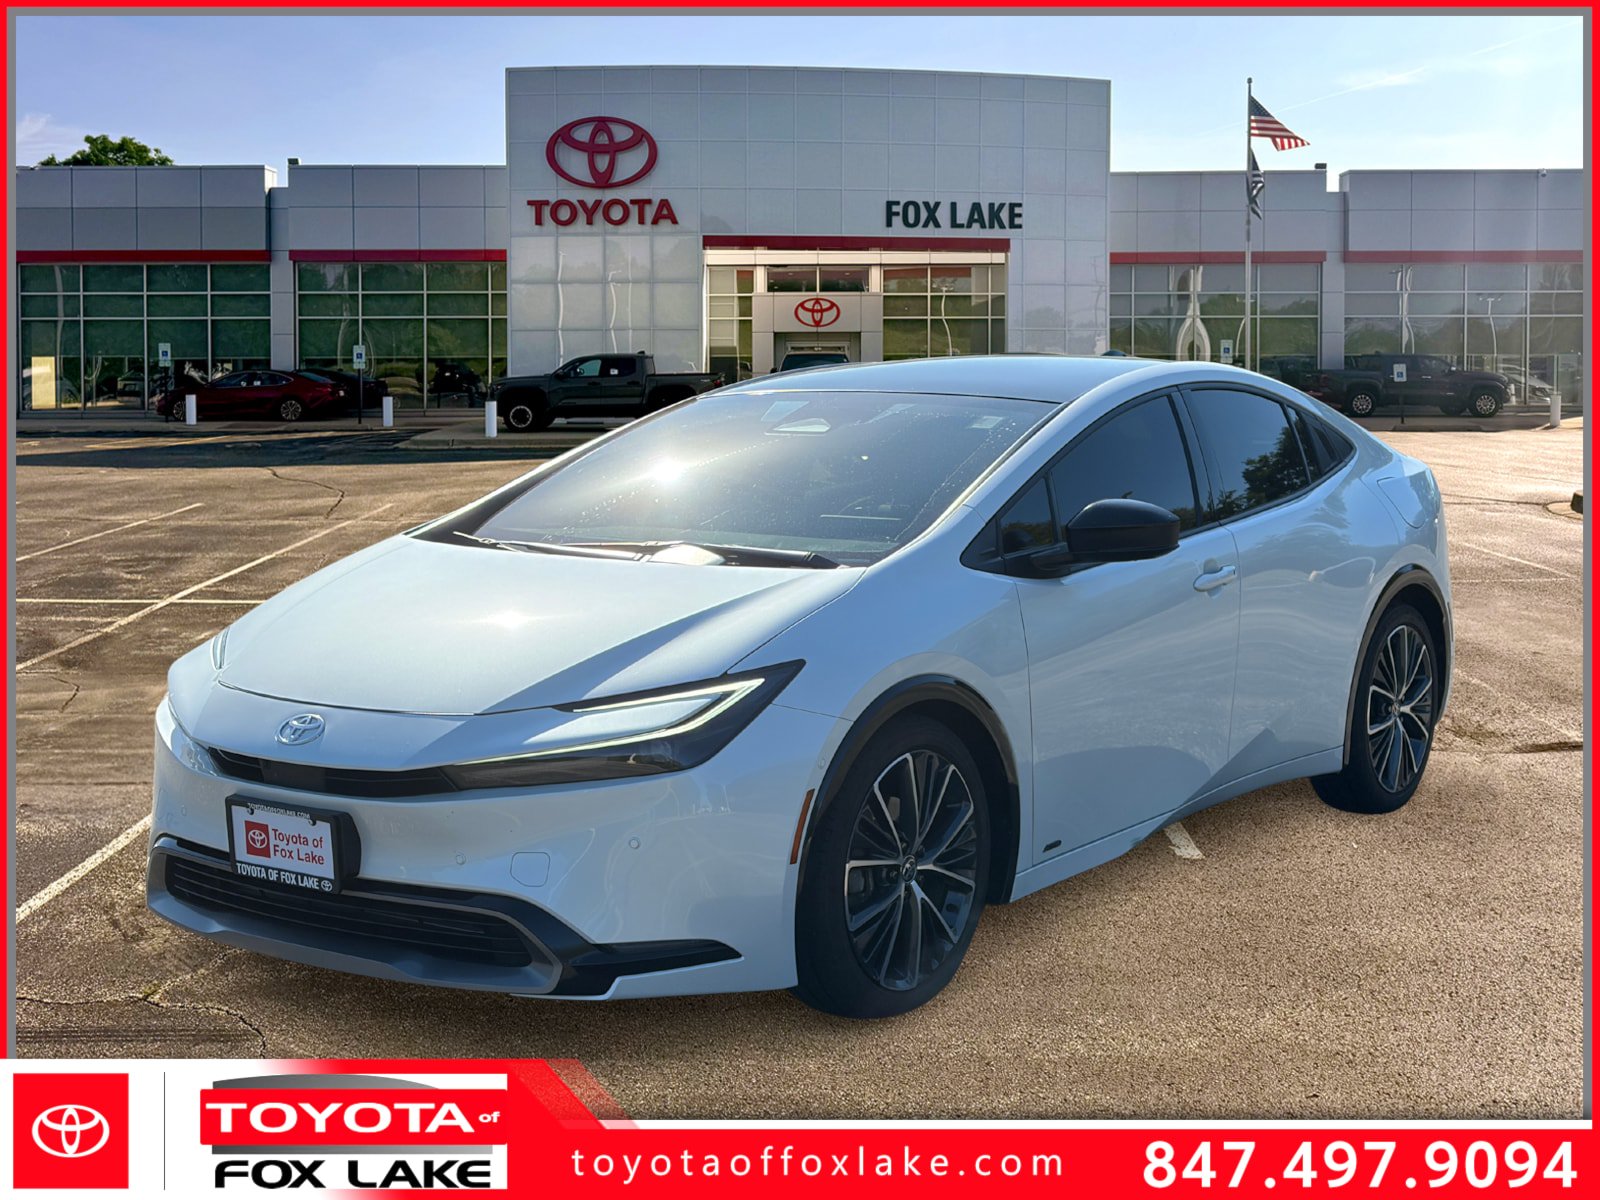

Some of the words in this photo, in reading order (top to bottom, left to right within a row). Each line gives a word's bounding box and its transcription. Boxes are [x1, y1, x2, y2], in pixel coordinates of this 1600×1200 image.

[527, 199, 678, 226] TOYOTA
[885, 200, 942, 229] FOX
[950, 201, 1023, 230] LAKE
[272, 828, 309, 846] Toyota
[312, 836, 323, 849] of
[273, 844, 294, 860] Fox
[297, 848, 325, 865] Lake
[236, 862, 267, 879] TOYOTA
[267, 870, 279, 881] OF
[280, 873, 297, 885] FOX
[298, 875, 320, 890] LAKE
